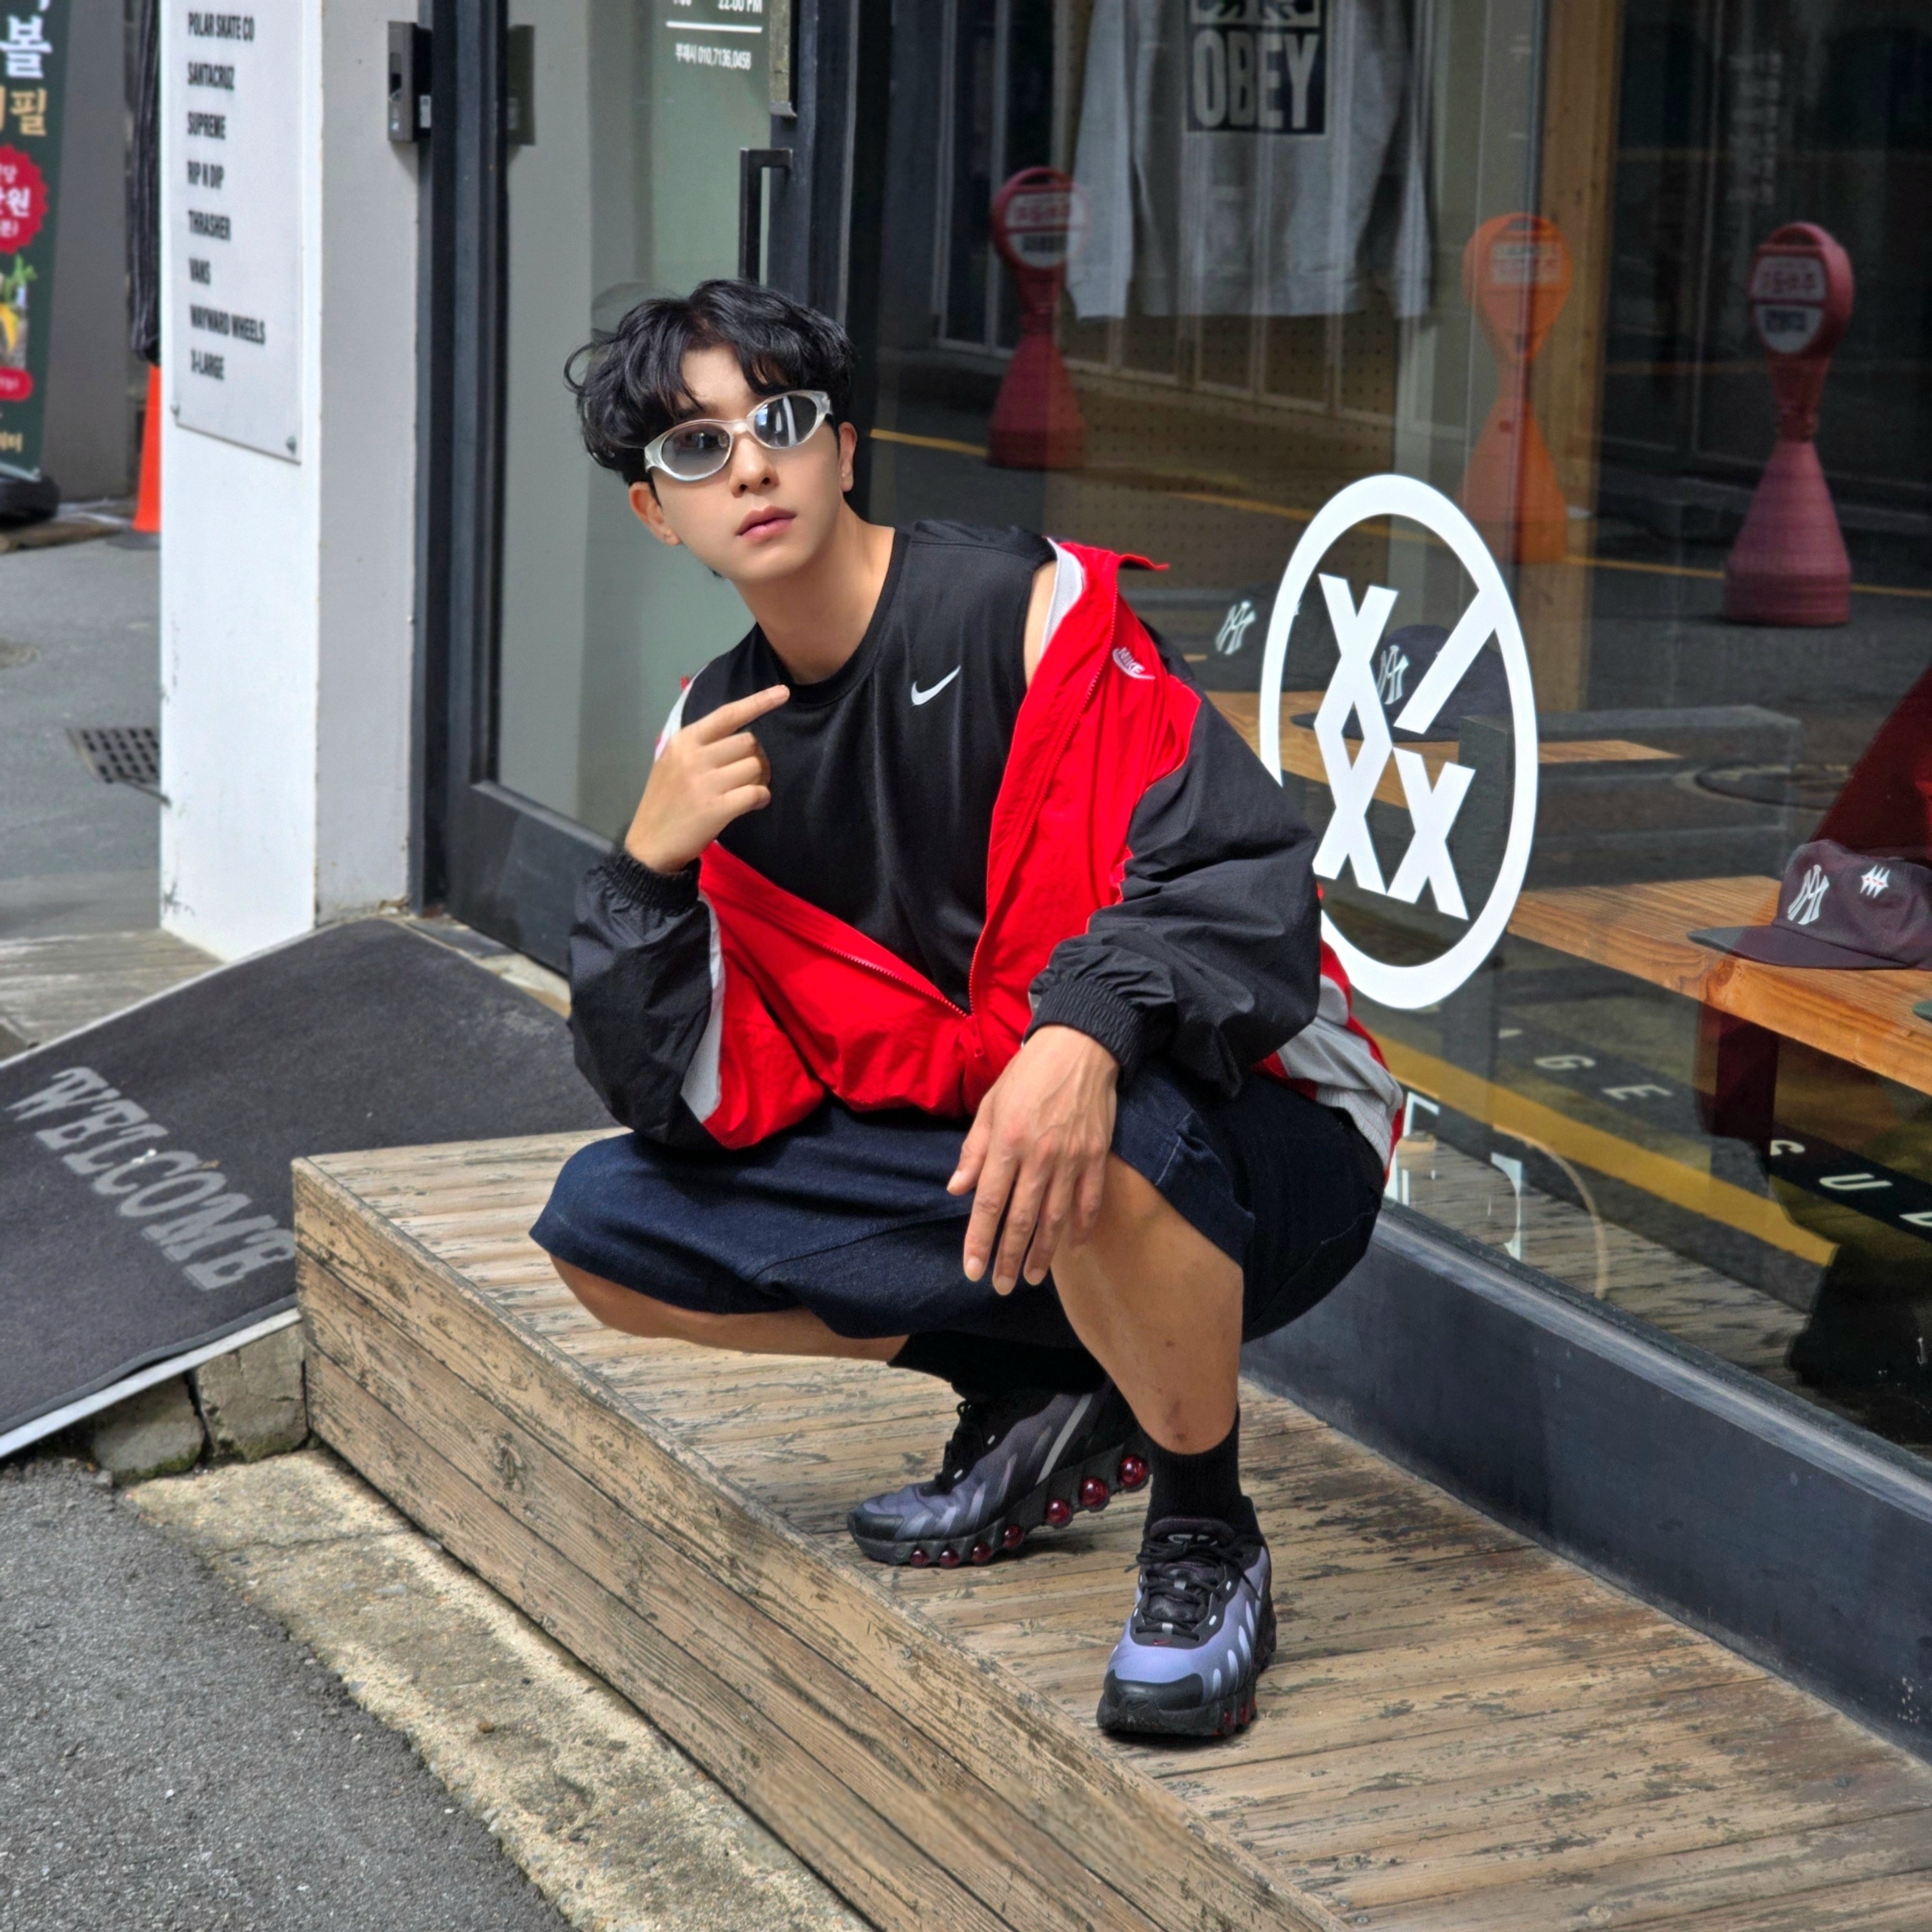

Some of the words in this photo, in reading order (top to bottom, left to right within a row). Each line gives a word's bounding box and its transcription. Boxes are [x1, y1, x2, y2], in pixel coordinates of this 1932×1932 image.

[189, 12, 214, 37] POLAR
[216, 14, 242, 41] SKATE
[243, 16, 254, 41] CO
[1193, 29, 1320, 129] OBEY
[187, 111, 226, 140] SUPREME
[189, 209, 231, 242] THRASHER
[189, 256, 211, 285] VANS
[231, 313, 265, 345] WHEELS
[1118, 646, 1146, 674] NIKE
[5, 1065, 295, 1291] WELCOME
